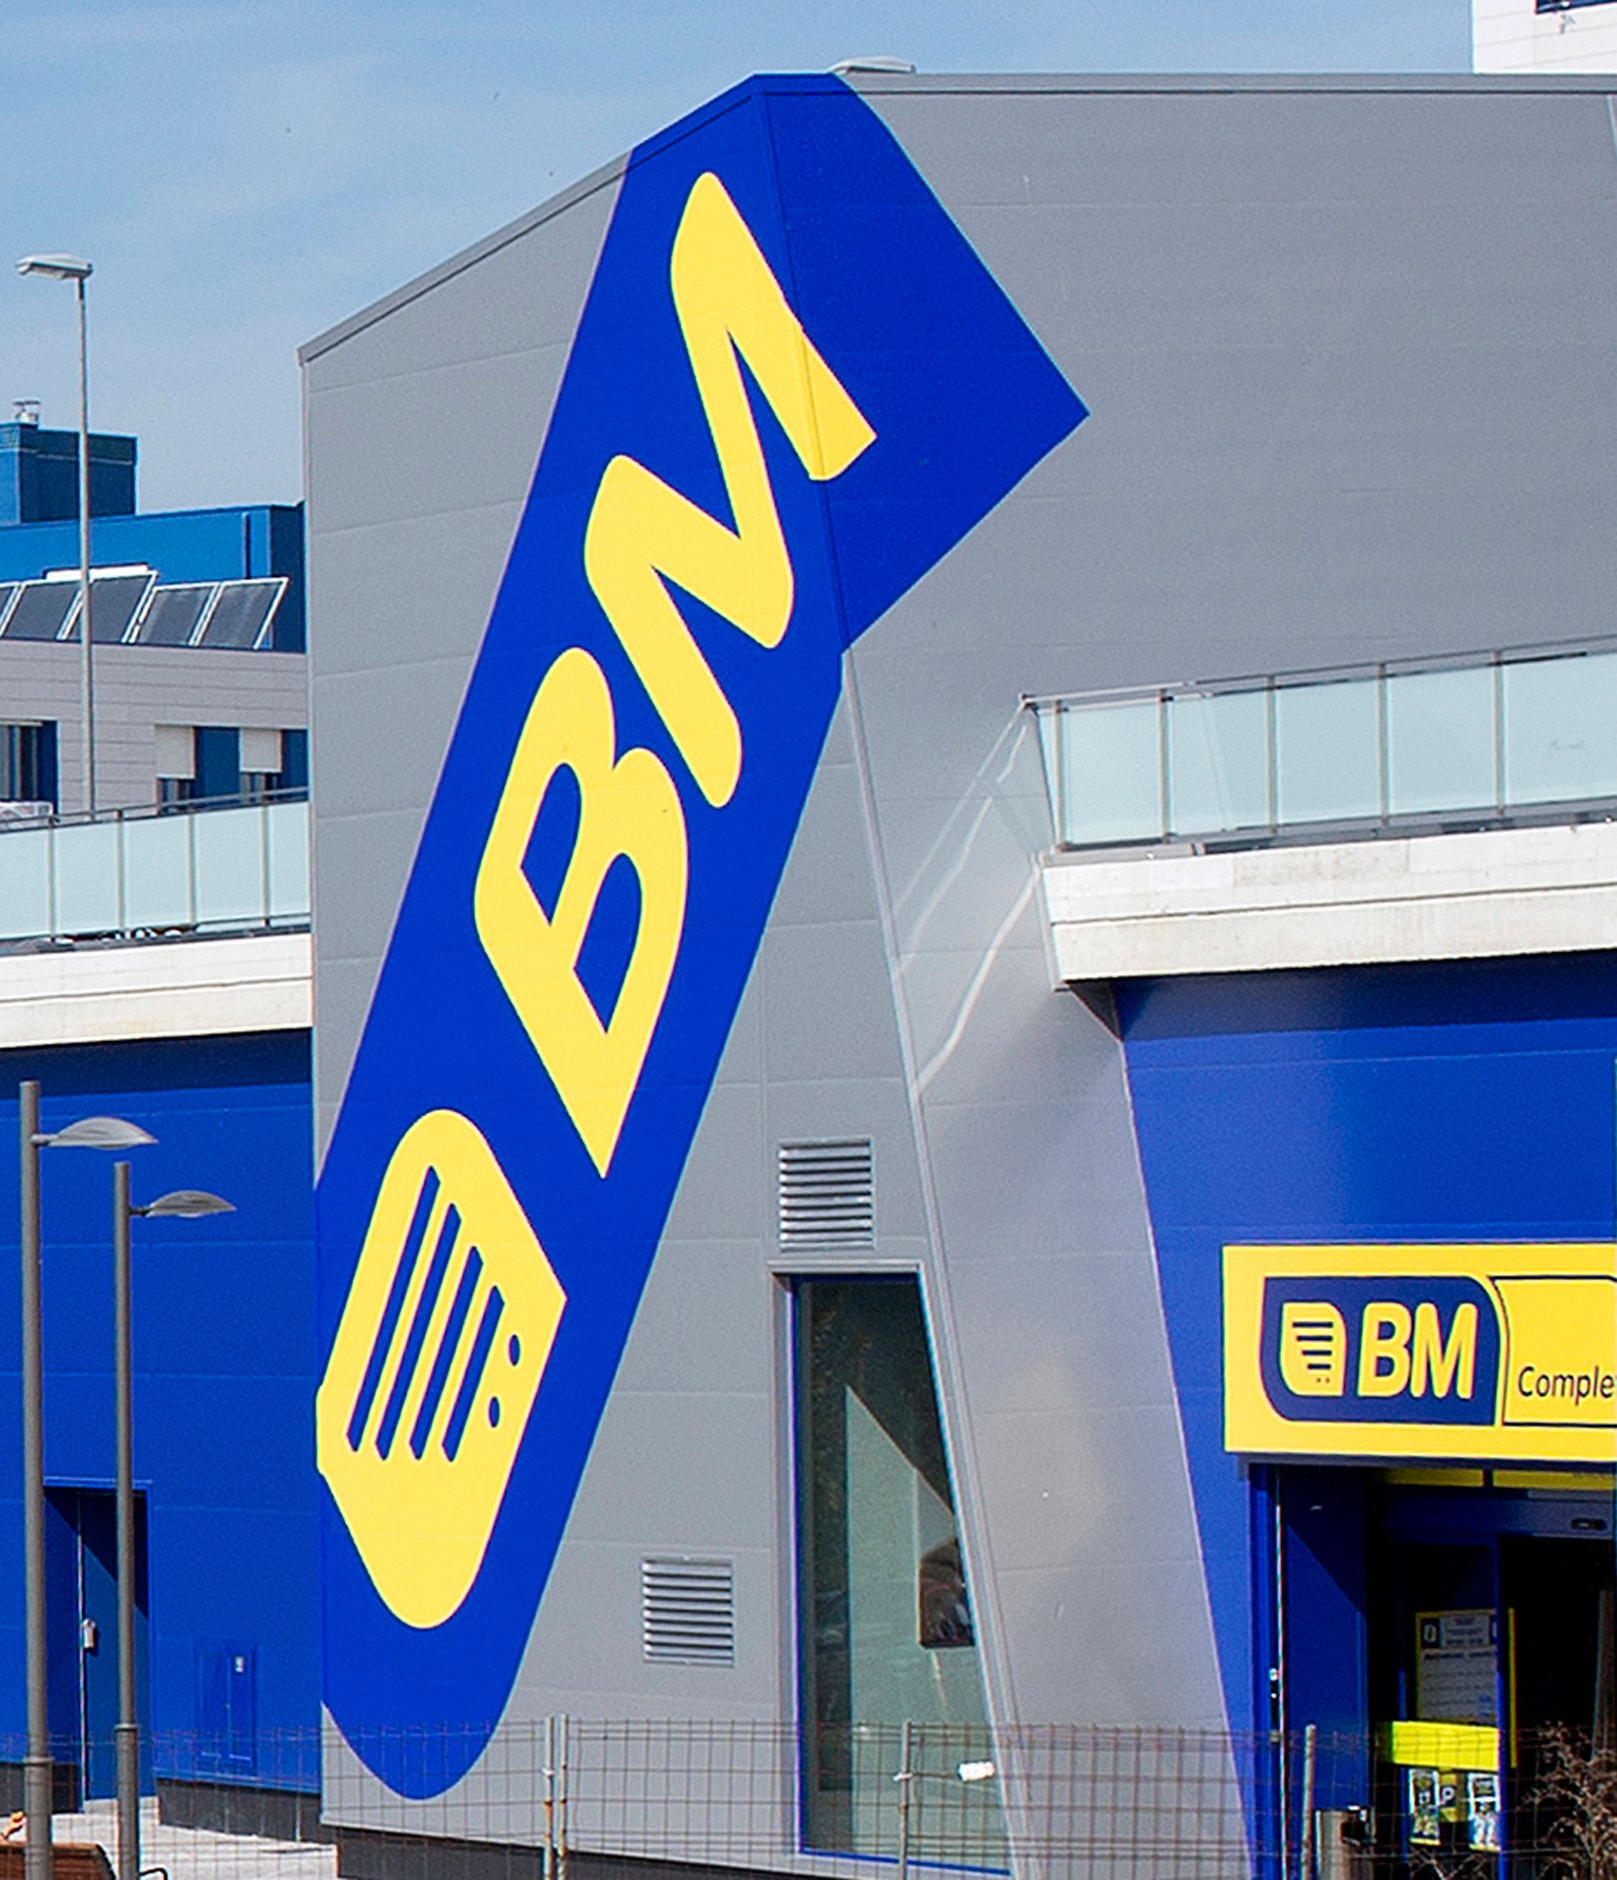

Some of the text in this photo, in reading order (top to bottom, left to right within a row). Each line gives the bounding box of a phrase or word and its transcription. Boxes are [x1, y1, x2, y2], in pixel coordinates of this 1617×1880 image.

[474, 172, 877, 1179] BM
[1357, 1302, 1477, 1398] BM
[1518, 1365, 1617, 1407] Comple
